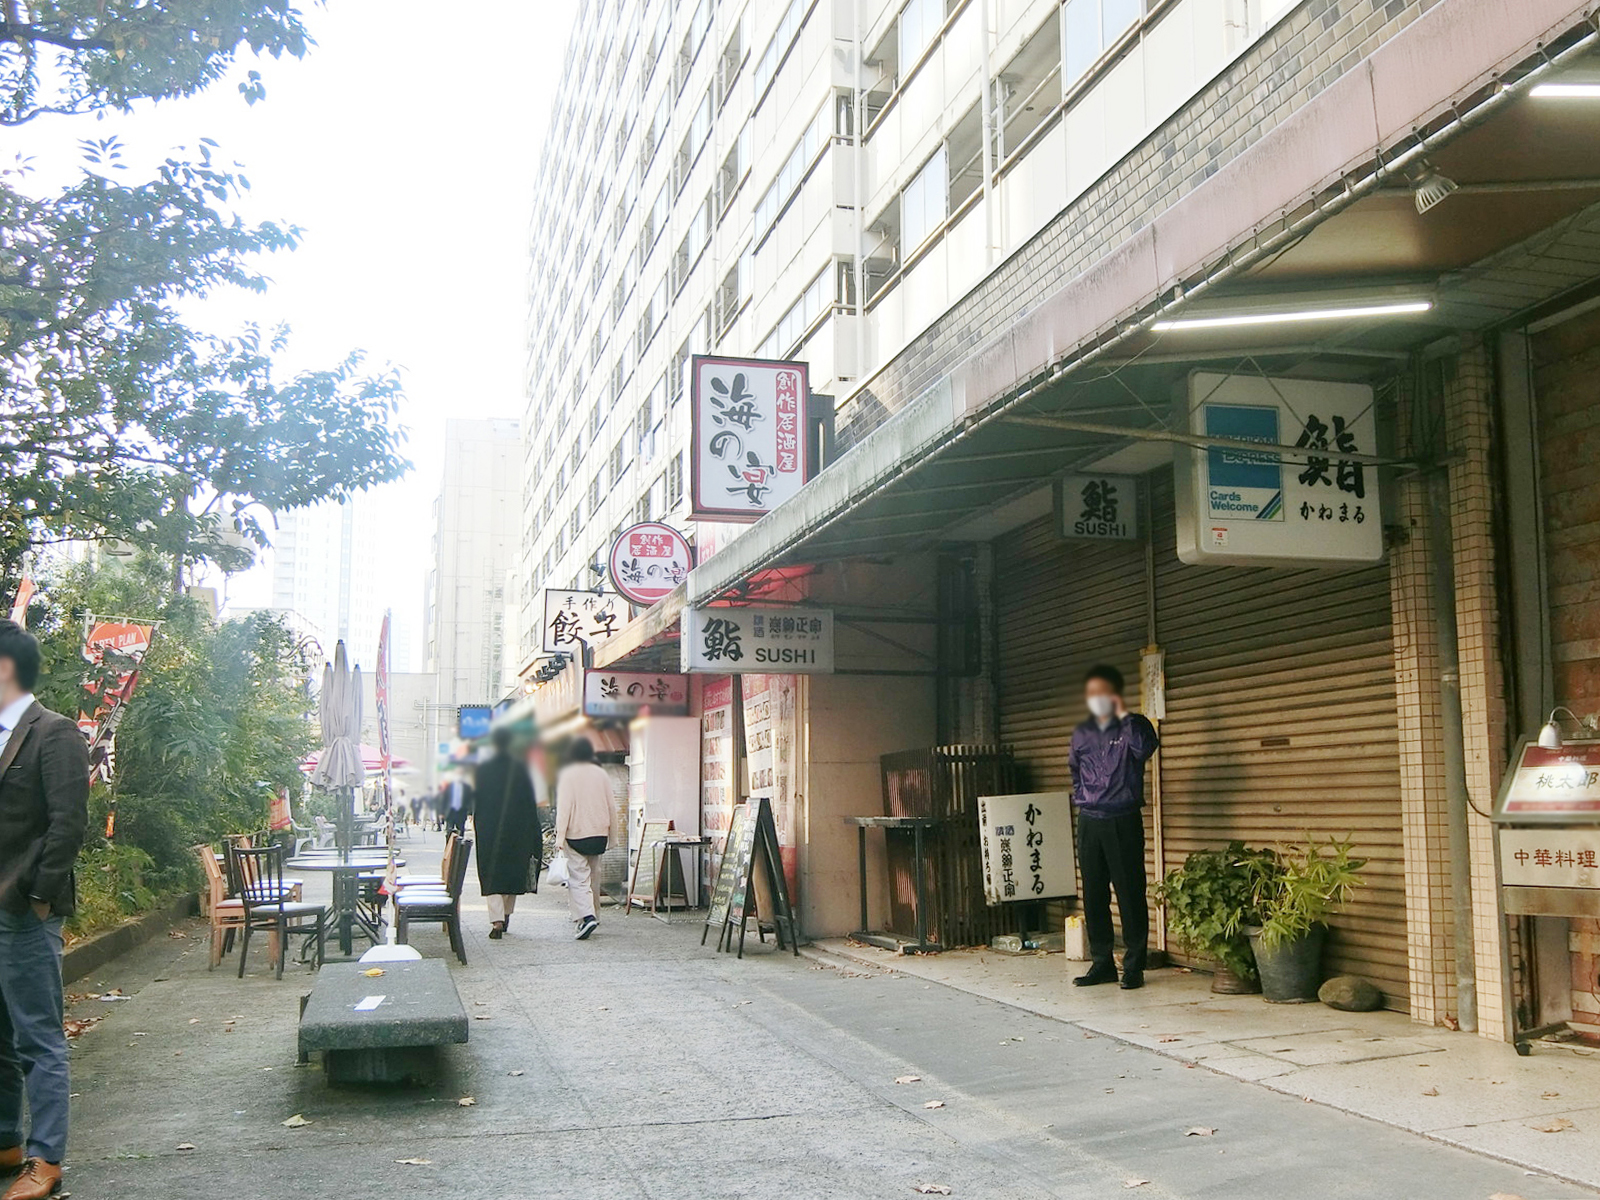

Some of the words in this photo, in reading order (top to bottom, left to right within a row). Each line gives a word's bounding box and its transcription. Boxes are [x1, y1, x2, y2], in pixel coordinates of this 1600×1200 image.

[777, 372, 796, 471] 創作居酒屋
[709, 373, 775, 505] 海の宴
[1295, 414, 1365, 499] 鮨
[1080, 480, 1118, 523] 鮨
[1210, 491, 1241, 501] Cards
[1210, 501, 1258, 512] Welcome
[1300, 501, 1365, 523] かねまる
[639, 534, 664, 545] 創作
[1074, 521, 1126, 536] SUSHI
[631, 545, 672, 556] 居酒屋
[621, 558, 685, 585] 海の宴
[562, 596, 614, 611] 手作り
[118, 632, 137, 646] PLAN
[549, 610, 620, 646] 餃子
[702, 617, 744, 661] 鮨
[755, 648, 815, 663] SUSHI
[601, 677, 670, 701] 海の宴
[1025, 803, 1045, 895] かねまる
[1514, 849, 1598, 868] 中華料理
